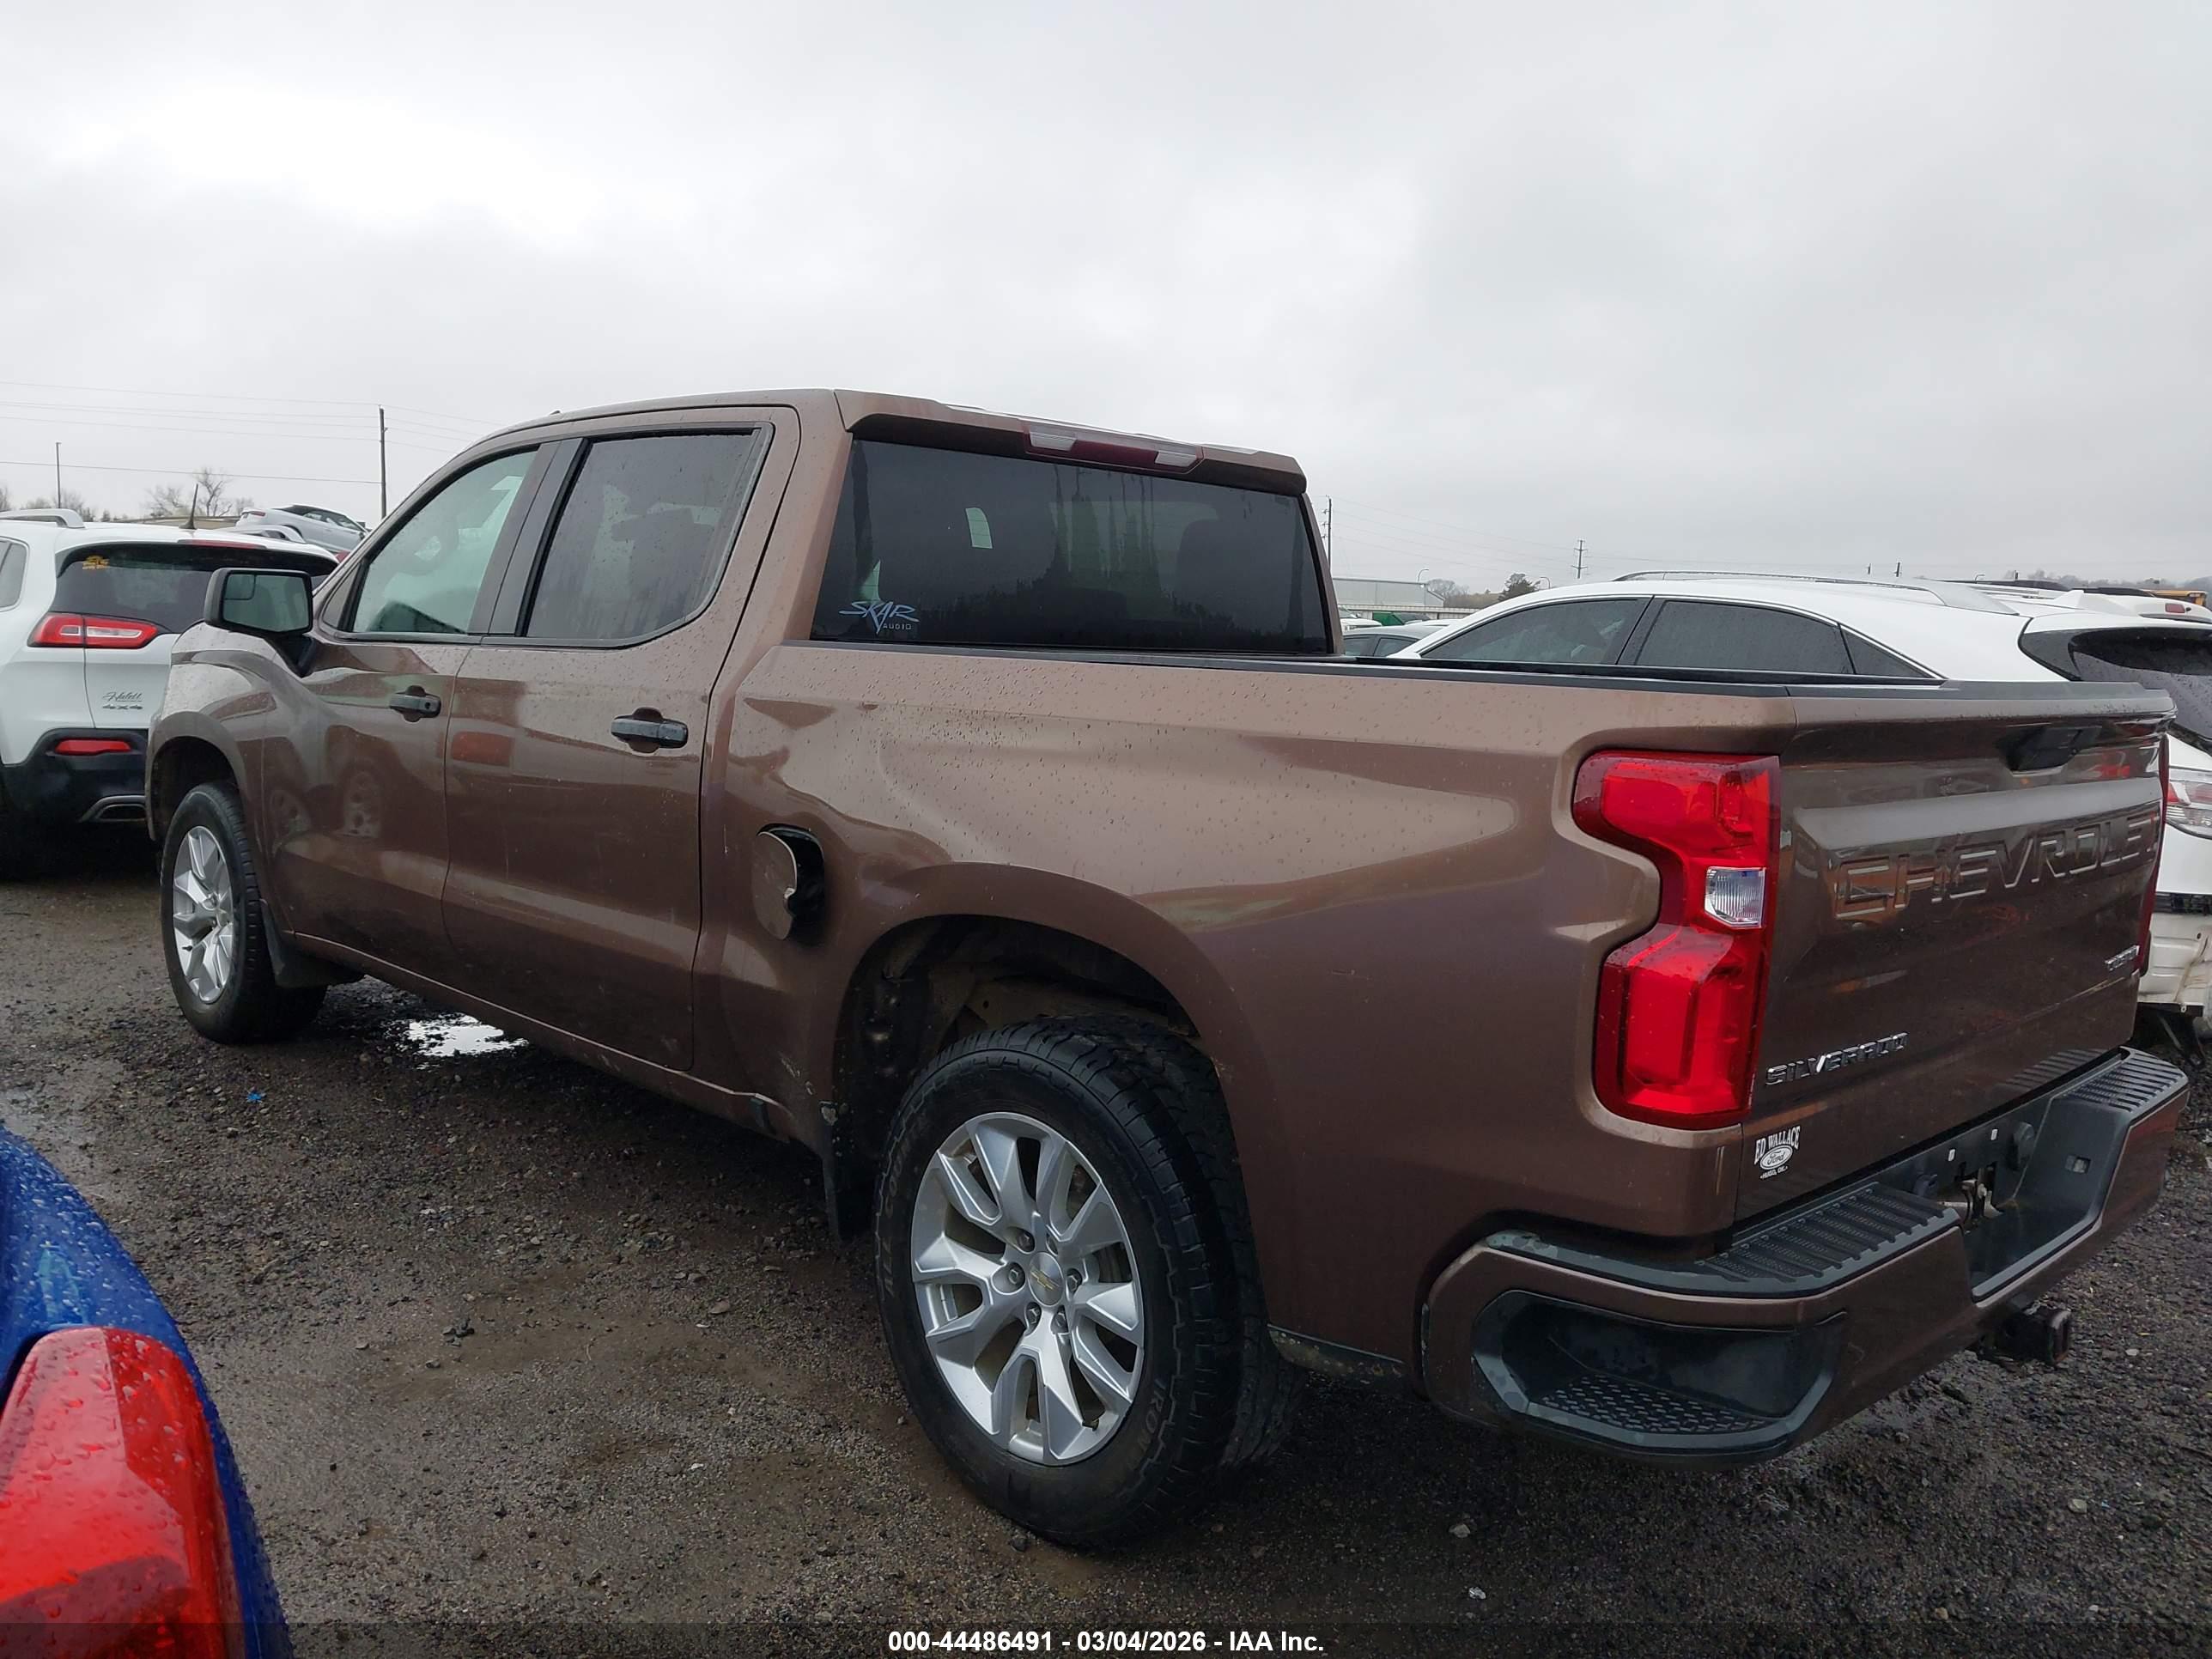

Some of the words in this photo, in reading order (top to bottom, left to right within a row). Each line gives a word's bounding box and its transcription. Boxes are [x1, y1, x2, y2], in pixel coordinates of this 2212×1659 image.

[838, 601, 920, 634] SKAR
[1834, 809, 2160, 920] CHEVROLET
[1765, 1032, 1908, 1086] SILVERADO
[1753, 1137, 1766, 1165] ED
[1767, 1125, 1801, 1151] WALLACE
[1766, 1150, 1786, 1166] Ford
